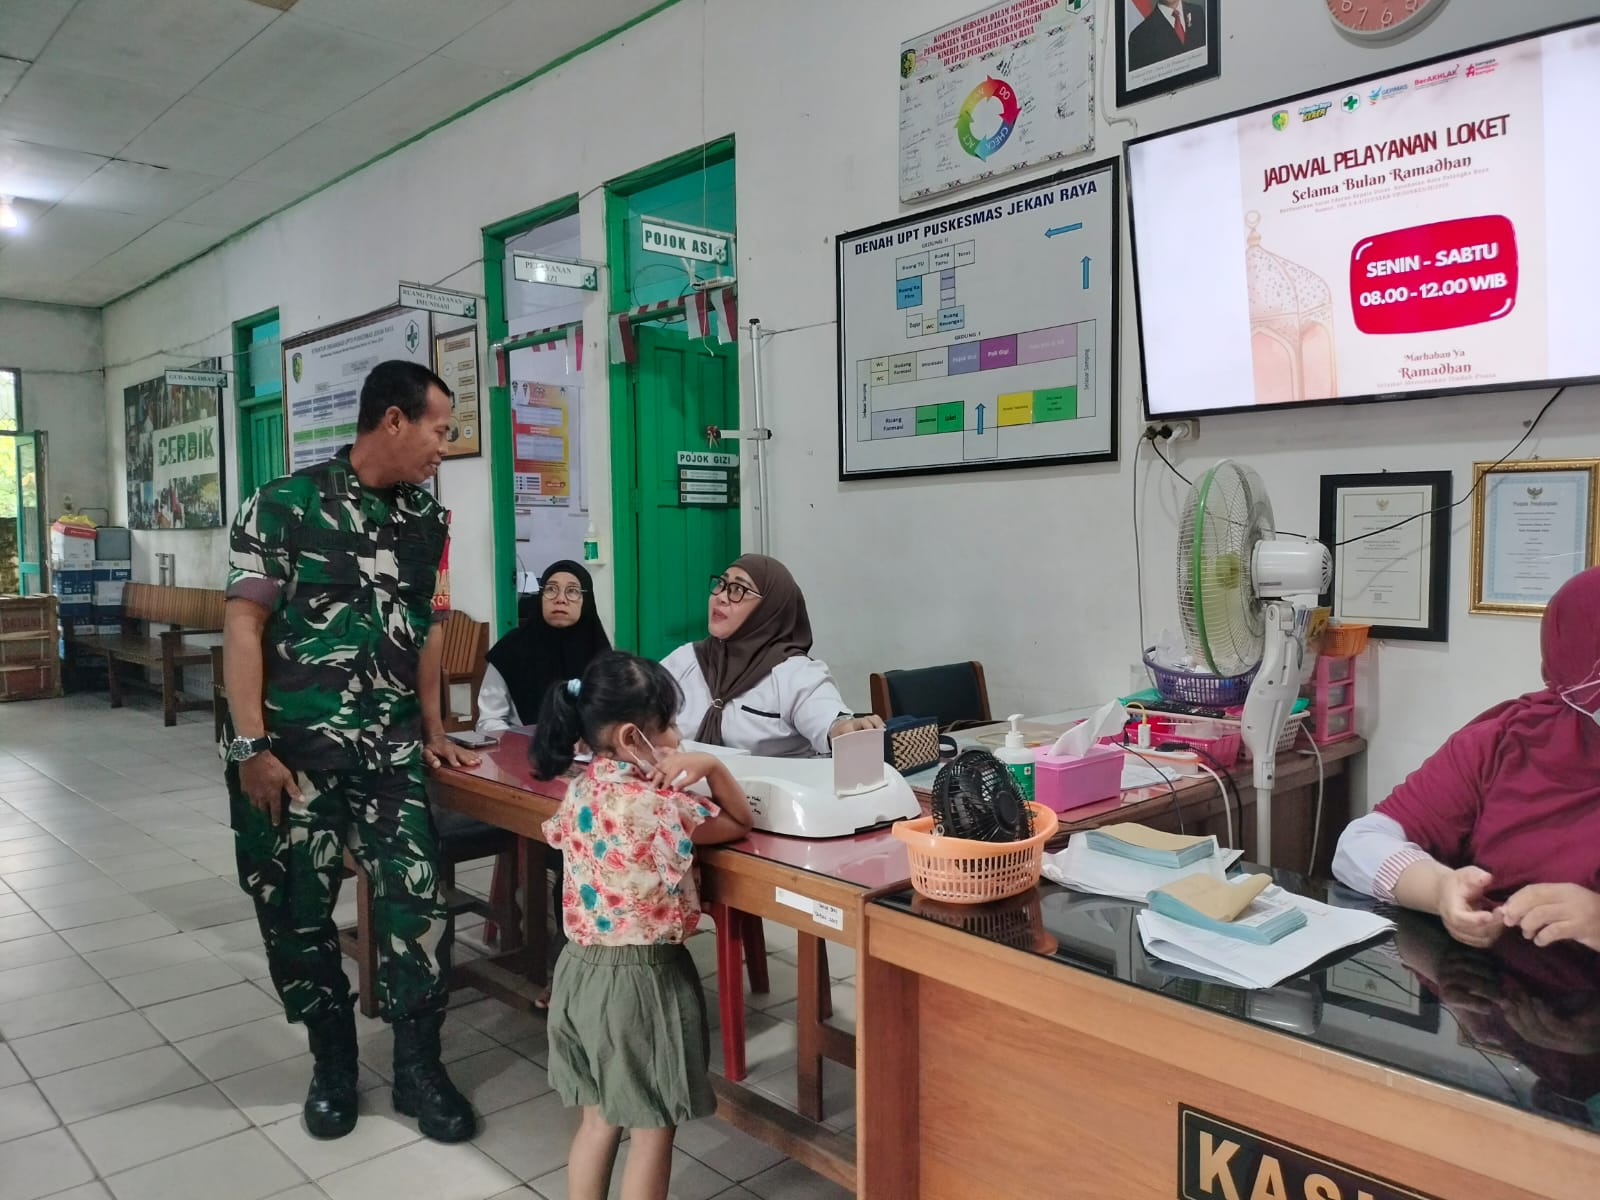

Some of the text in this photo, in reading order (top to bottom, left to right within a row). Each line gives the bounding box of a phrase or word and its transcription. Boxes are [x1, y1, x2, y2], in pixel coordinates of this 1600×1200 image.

[934, 24, 962, 44] KOMITMEN
[963, 14, 989, 33] BERSAMA
[989, 7, 1010, 24] DALAM
[1357, 6, 1368, 25] 7
[1380, 6, 1393, 25] 6
[923, 36, 960, 57] PENINGKATAN
[960, 31, 975, 45] MUTU
[976, 18, 1009, 39] PELAYANAN
[1009, 12, 1022, 26] DAN
[960, 37, 981, 52] SECARA
[967, 41, 999, 59] PUSKESMAS
[999, 33, 1018, 47] JEKAN
[1018, 25, 1035, 40] RAYA
[999, 86, 1011, 100] DO
[985, 127, 1009, 149] CHECK
[1263, 113, 1511, 193] JADWAL PELAYANAN LOKET
[1291, 184, 1339, 205] Selama
[1342, 173, 1387, 193] Bulan
[1389, 156, 1473, 182] Ramadhan
[855, 180, 1098, 256] DENAH UPT PUSKESMAS JEKAN RAYA
[644, 229, 713, 256] POJOK ASI
[525, 261, 572, 274] PEYANAN
[1366, 255, 1421, 278] SENIN
[1434, 242, 1499, 267] SABTU
[402, 288, 463, 305] RUANG PELAYANAN
[1359, 286, 1409, 307] 08.00
[1419, 277, 1469, 299] 12.00
[1468, 271, 1508, 292] WIB
[416, 298, 451, 311] IMUNISASI
[1404, 348, 1466, 362] Marhaban Ya
[1398, 362, 1473, 380] Ramadhan
[158, 426, 216, 467] CERDIK
[680, 454, 731, 465] POJOK GIZI
[1199, 1130, 1375, 1200] KA
